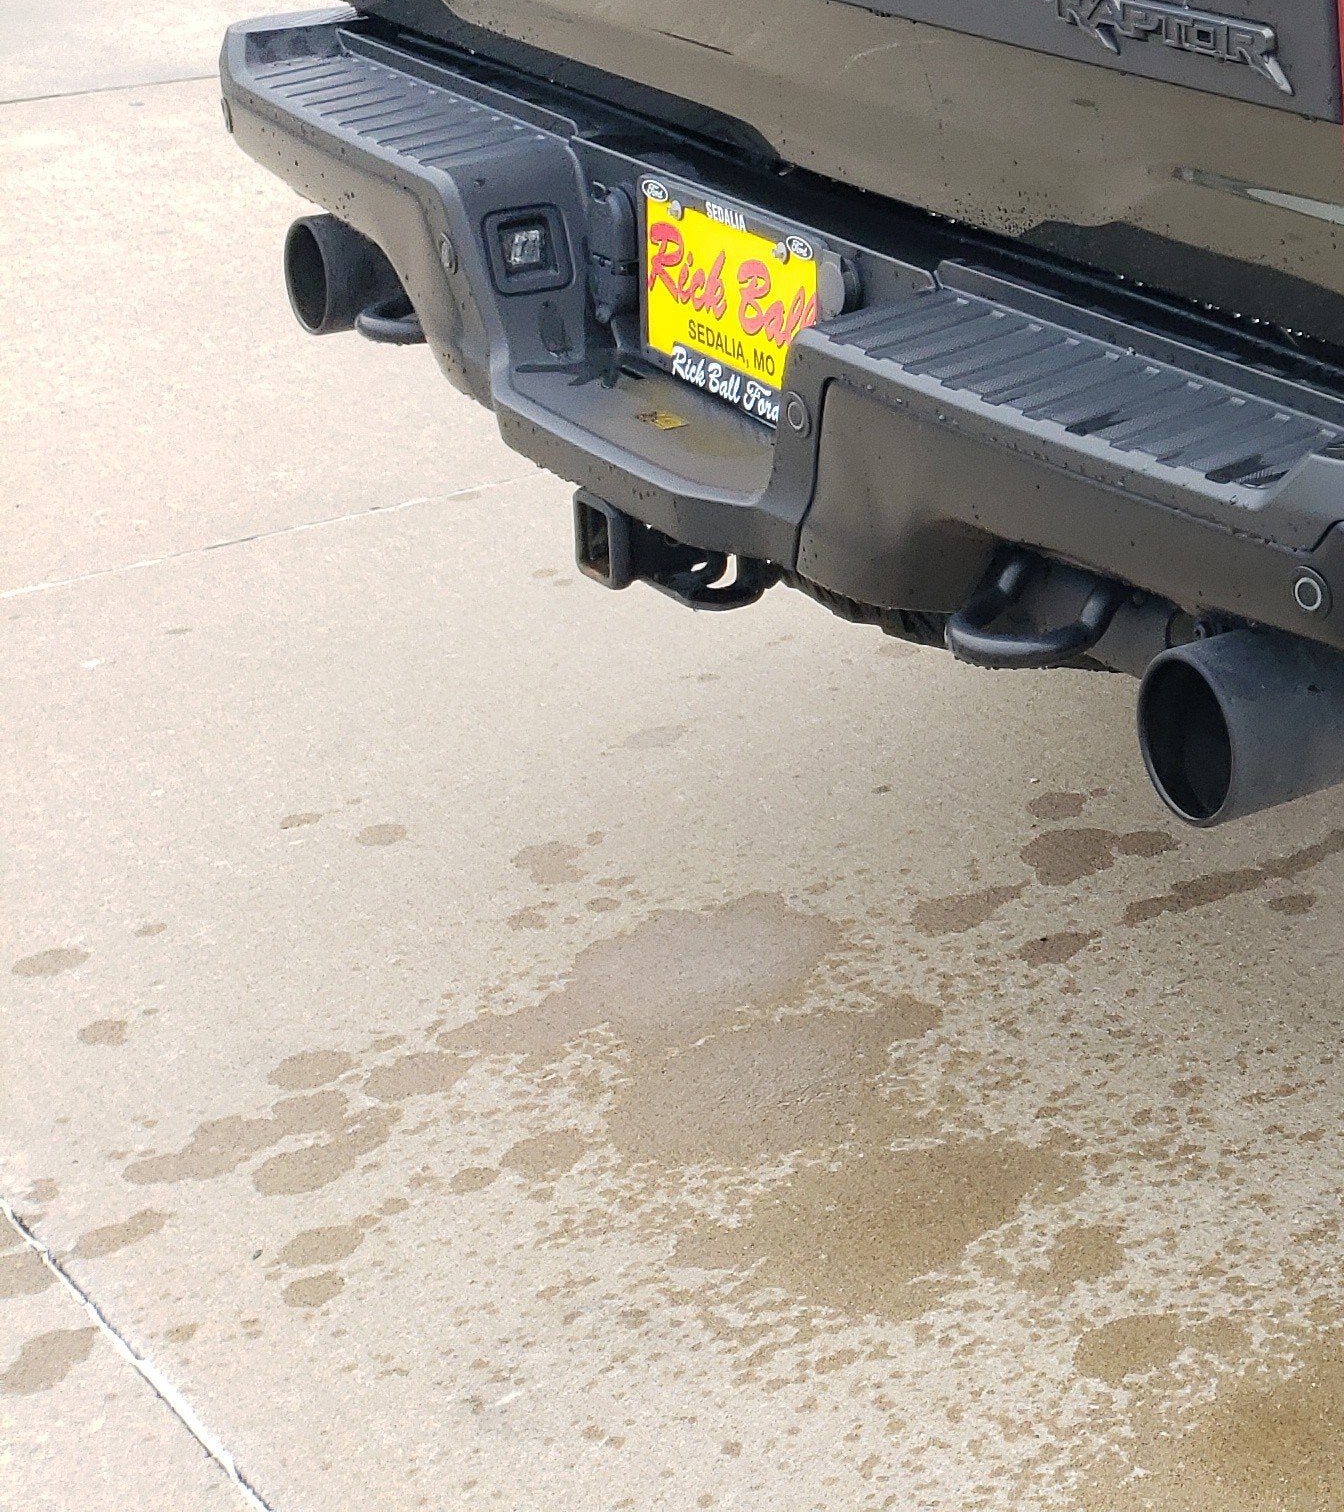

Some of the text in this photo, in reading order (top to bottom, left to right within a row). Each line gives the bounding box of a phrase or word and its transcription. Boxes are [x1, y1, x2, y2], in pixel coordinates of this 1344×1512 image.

[706, 201, 746, 231] SEDALIA
[648, 222, 817, 347] Rick Ball
[671, 345, 706, 387] Rick
[708, 362, 741, 403] Ball
[688, 319, 775, 376] SEDALIA, MO
